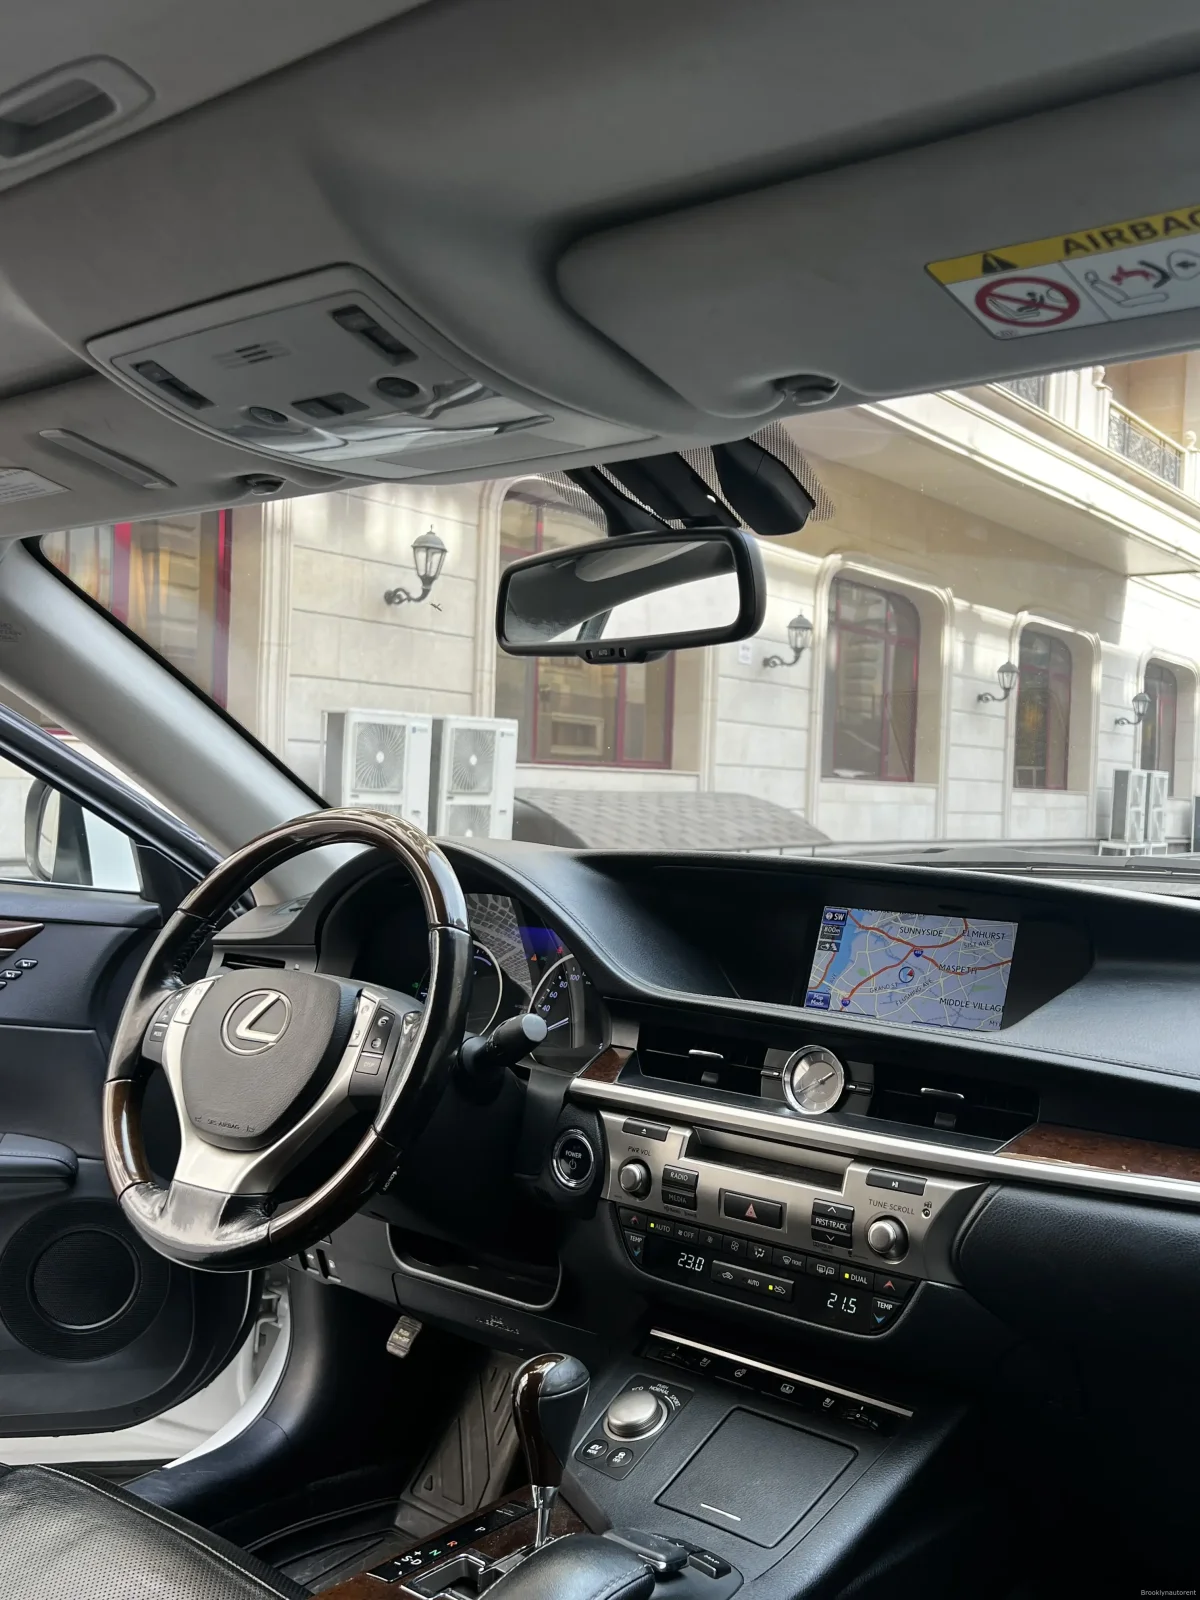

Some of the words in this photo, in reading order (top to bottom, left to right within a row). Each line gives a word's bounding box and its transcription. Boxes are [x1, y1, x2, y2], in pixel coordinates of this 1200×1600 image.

[834, 913, 845, 921] SW
[899, 926, 943, 938] SUNNYSIDE
[962, 929, 1006, 941] ELMHURST
[938, 963, 978, 975] MASPETH
[570, 973, 580, 982] 100
[559, 980, 568, 989] 80
[869, 983, 891, 994] GRAND
[550, 991, 558, 999] 60
[896, 986, 922, 1007] FLUSHING
[542, 1004, 551, 1012] 40
[940, 997, 970, 1009] MIDDLE
[972, 1002, 1004, 1013] VILLAG
[565, 1150, 582, 1159] POWER
[670, 1171, 689, 1182] RADIO
[668, 1193, 687, 1205] MEDIA
[655, 1223, 671, 1233] AUTO
[629, 1234, 643, 1243] TEMP
[683, 1230, 695, 1239] OFF
[677, 1252, 705, 1272] 23.0
[747, 1278, 760, 1287] AUTO
[850, 1273, 868, 1285] DUAL
[827, 1292, 857, 1314] 21.5
[876, 1300, 893, 1311] TEMP
[649, 1385, 669, 1395] NORMAL
[670, 1394, 681, 1407] SPORT
